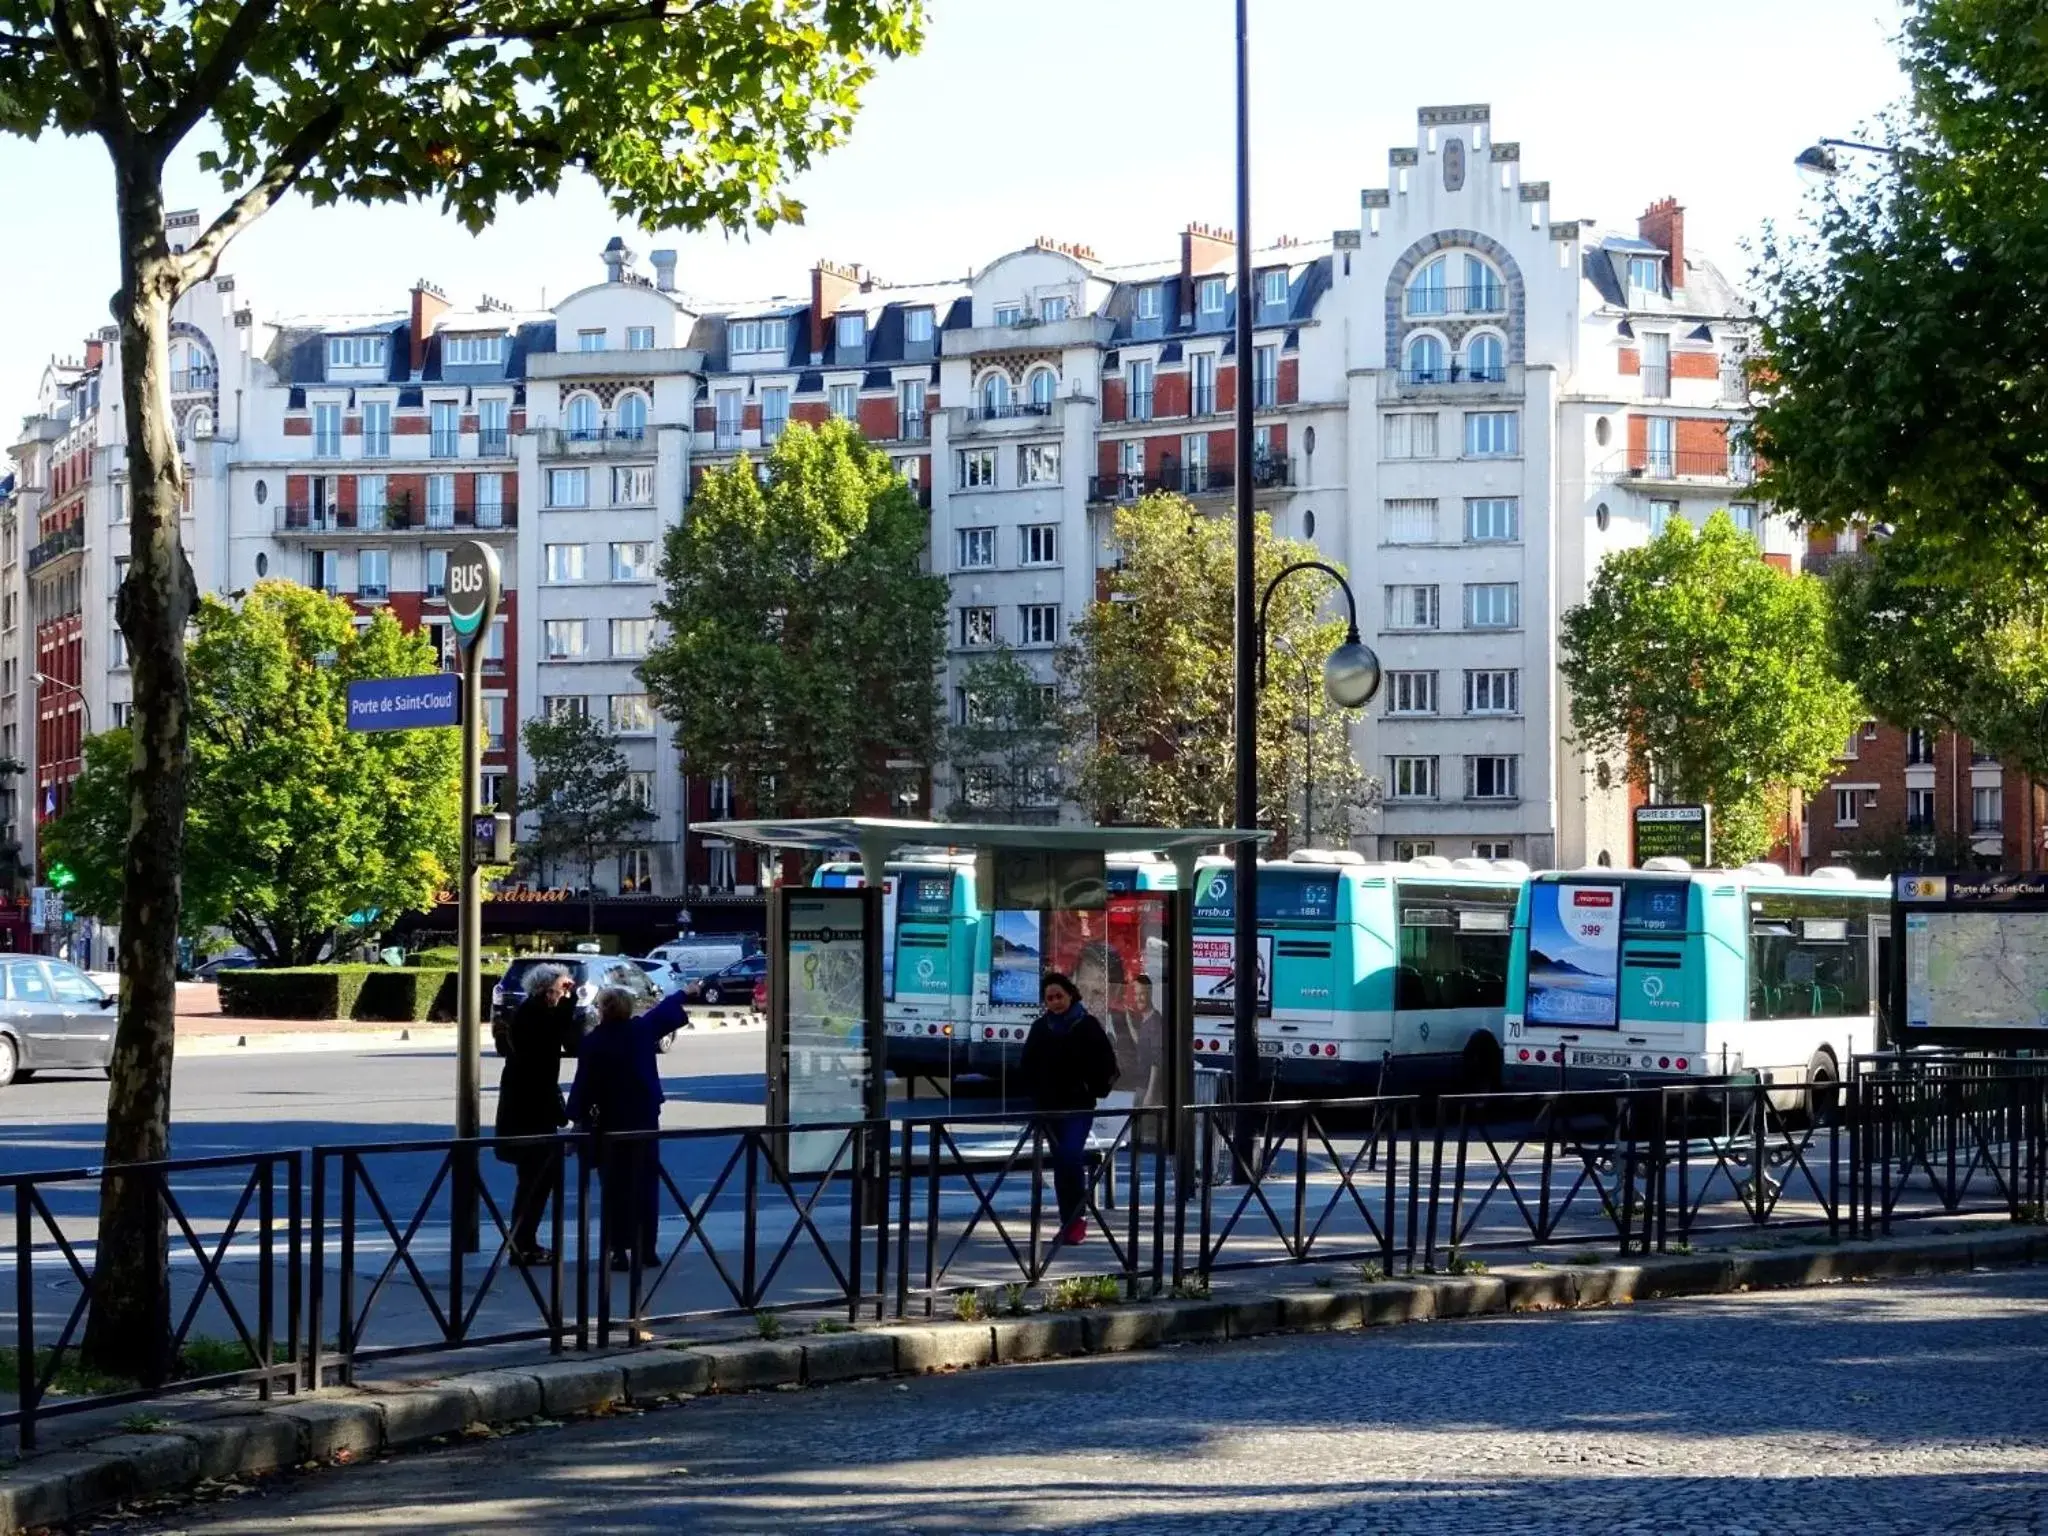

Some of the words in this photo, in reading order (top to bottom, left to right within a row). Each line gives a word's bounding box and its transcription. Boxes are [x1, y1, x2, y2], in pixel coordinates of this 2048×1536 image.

[451, 563, 483, 594] BUS
[351, 700, 379, 715] Porte
[380, 696, 393, 712] de
[395, 691, 453, 711] Saint-Cloud
[475, 822, 493, 837] PC1
[1305, 885, 1328, 904] 62
[1953, 883, 1978, 894] Porte
[1980, 883, 1991, 894] de
[1993, 883, 2045, 894] Saint-Cloud
[1652, 893, 1677, 912] 62
[1192, 942, 1209, 950] MON
[1210, 942, 1230, 951] CLUB
[1192, 950, 1204, 958] MA
[1205, 950, 1230, 959] FORME
[1509, 1022, 1521, 1038] 70
